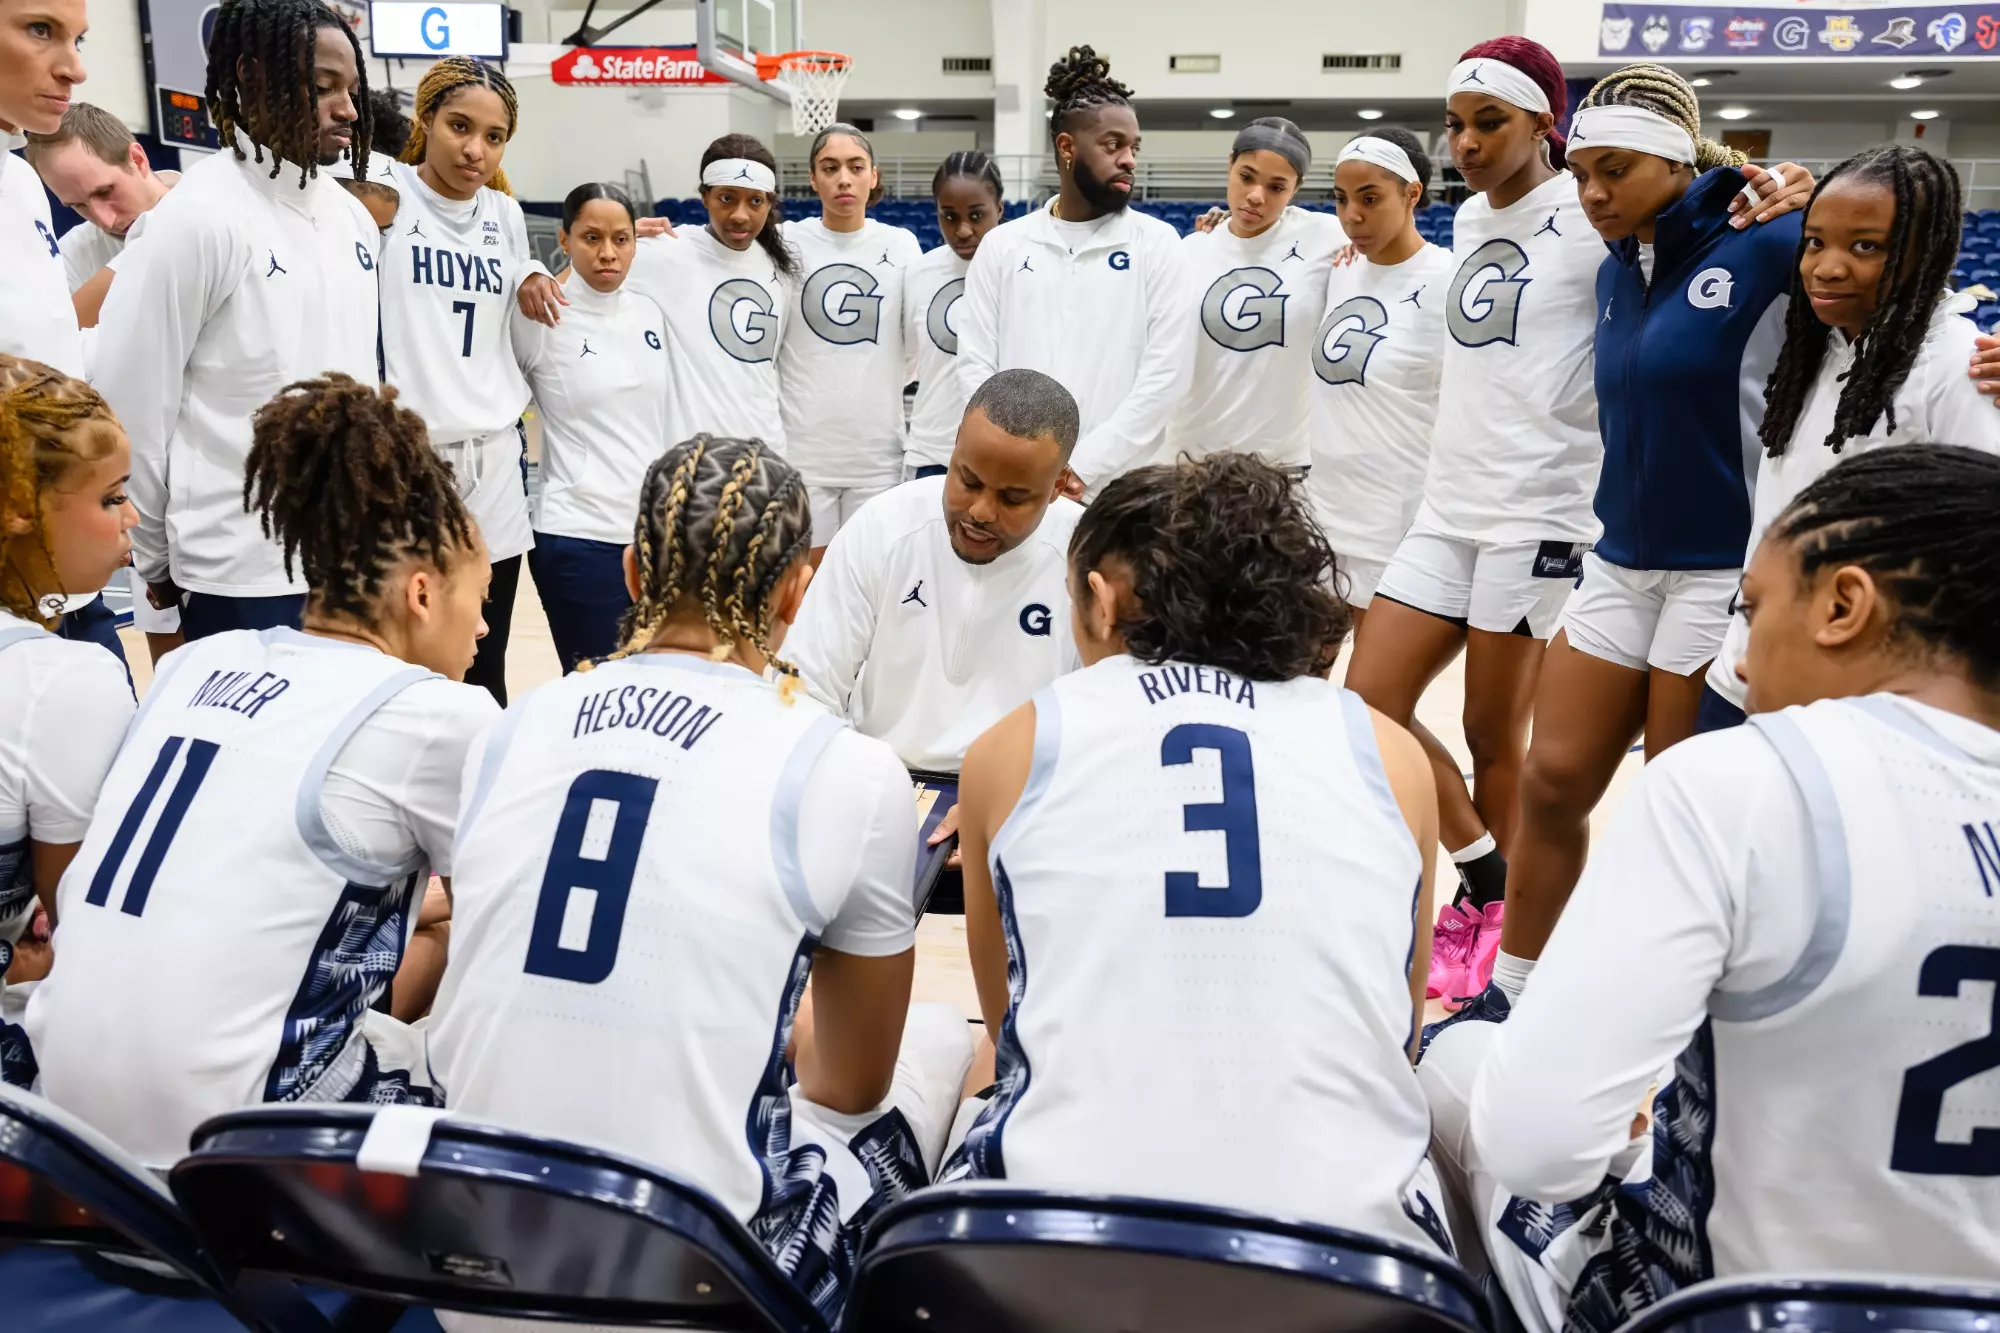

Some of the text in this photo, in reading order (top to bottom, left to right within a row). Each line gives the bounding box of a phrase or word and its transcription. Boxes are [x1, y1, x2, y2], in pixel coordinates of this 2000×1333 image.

[421, 7, 450, 50] G
[1773, 16, 1810, 50] G
[355, 241, 374, 271] G
[411, 245, 503, 295] HOYAS
[1108, 251, 1130, 271] G
[801, 263, 884, 345] G
[1201, 266, 1291, 352] G
[1446, 238, 1534, 348] G
[1687, 267, 1735, 309] G
[453, 301, 476, 357] 7
[644, 330, 661, 350] G
[709, 278, 778, 363] G
[1312, 295, 1389, 387] G
[1018, 602, 1053, 637] G
[187, 670, 290, 719] MILLER
[1138, 666, 1255, 710] RIVERA
[573, 685, 723, 750] HESSION
[84, 736, 221, 918] 11
[1161, 723, 1262, 917] 3
[523, 769, 660, 984] 8
[1889, 944, 2000, 1175] 2
